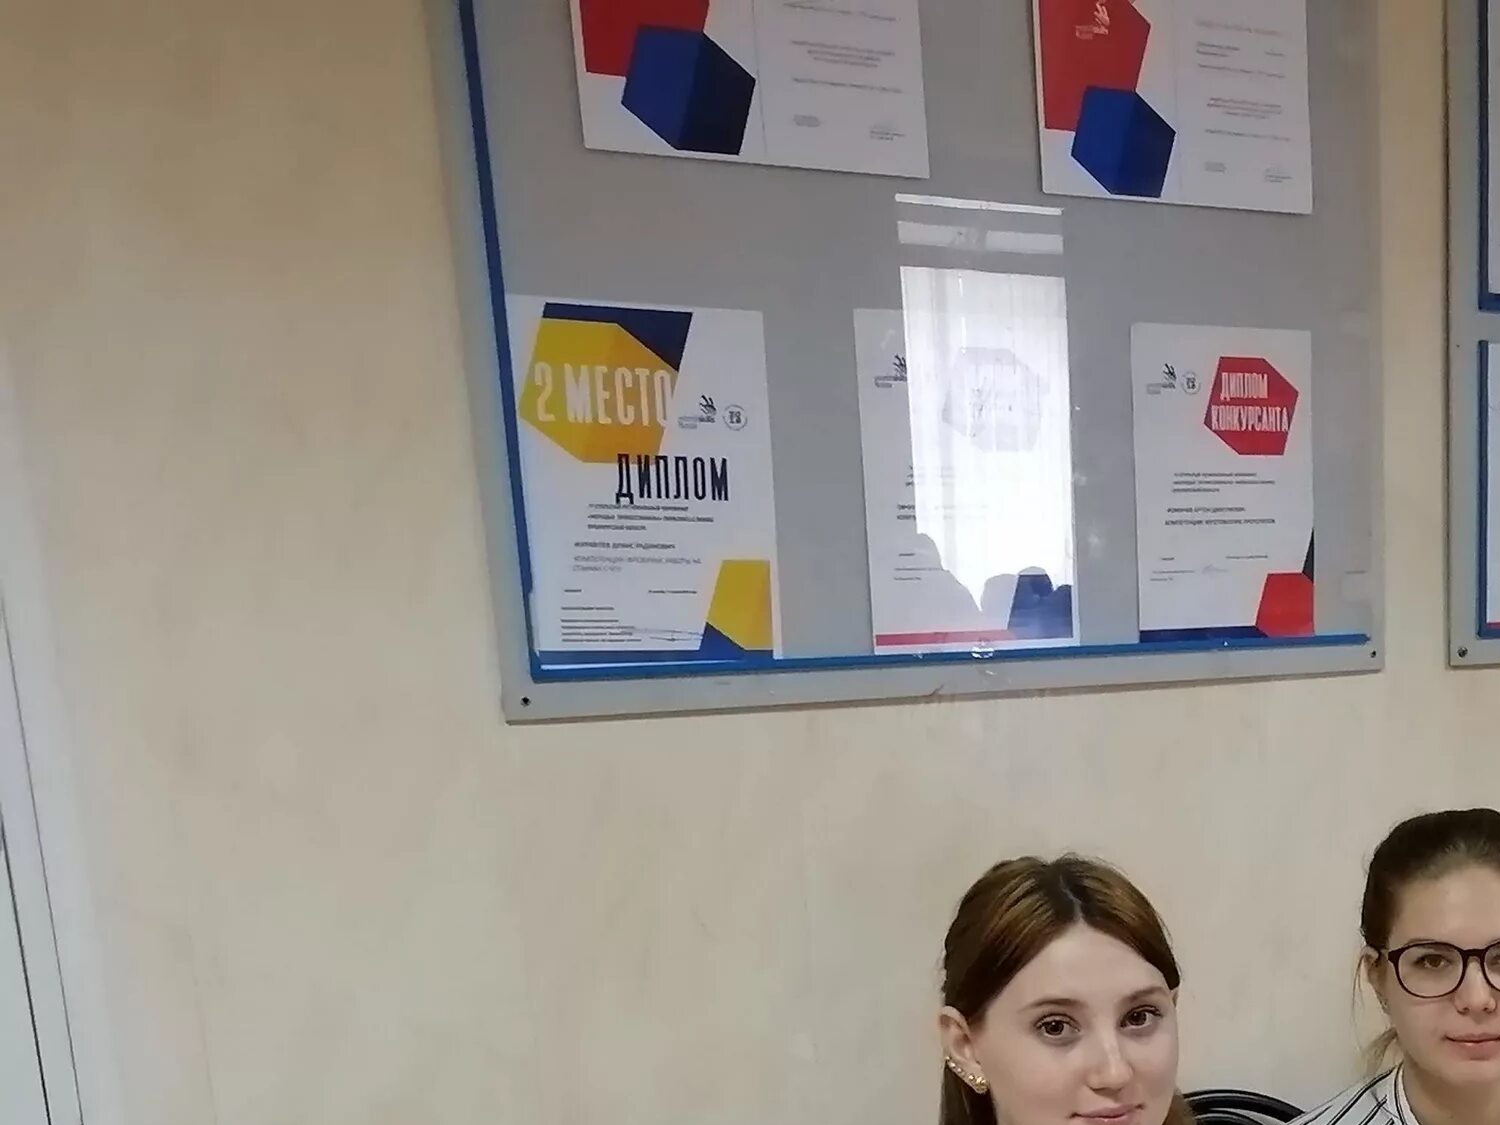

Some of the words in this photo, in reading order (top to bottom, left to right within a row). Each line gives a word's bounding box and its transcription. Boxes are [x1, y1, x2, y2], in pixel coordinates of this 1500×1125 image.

[534, 362, 556, 422] 2
[564, 363, 673, 428] МЕСТО
[1220, 371, 1269, 401] ДИПЛОМ
[1211, 404, 1289, 432] КОНКУРСАНТА
[616, 453, 729, 504] ДИПЛОМ
